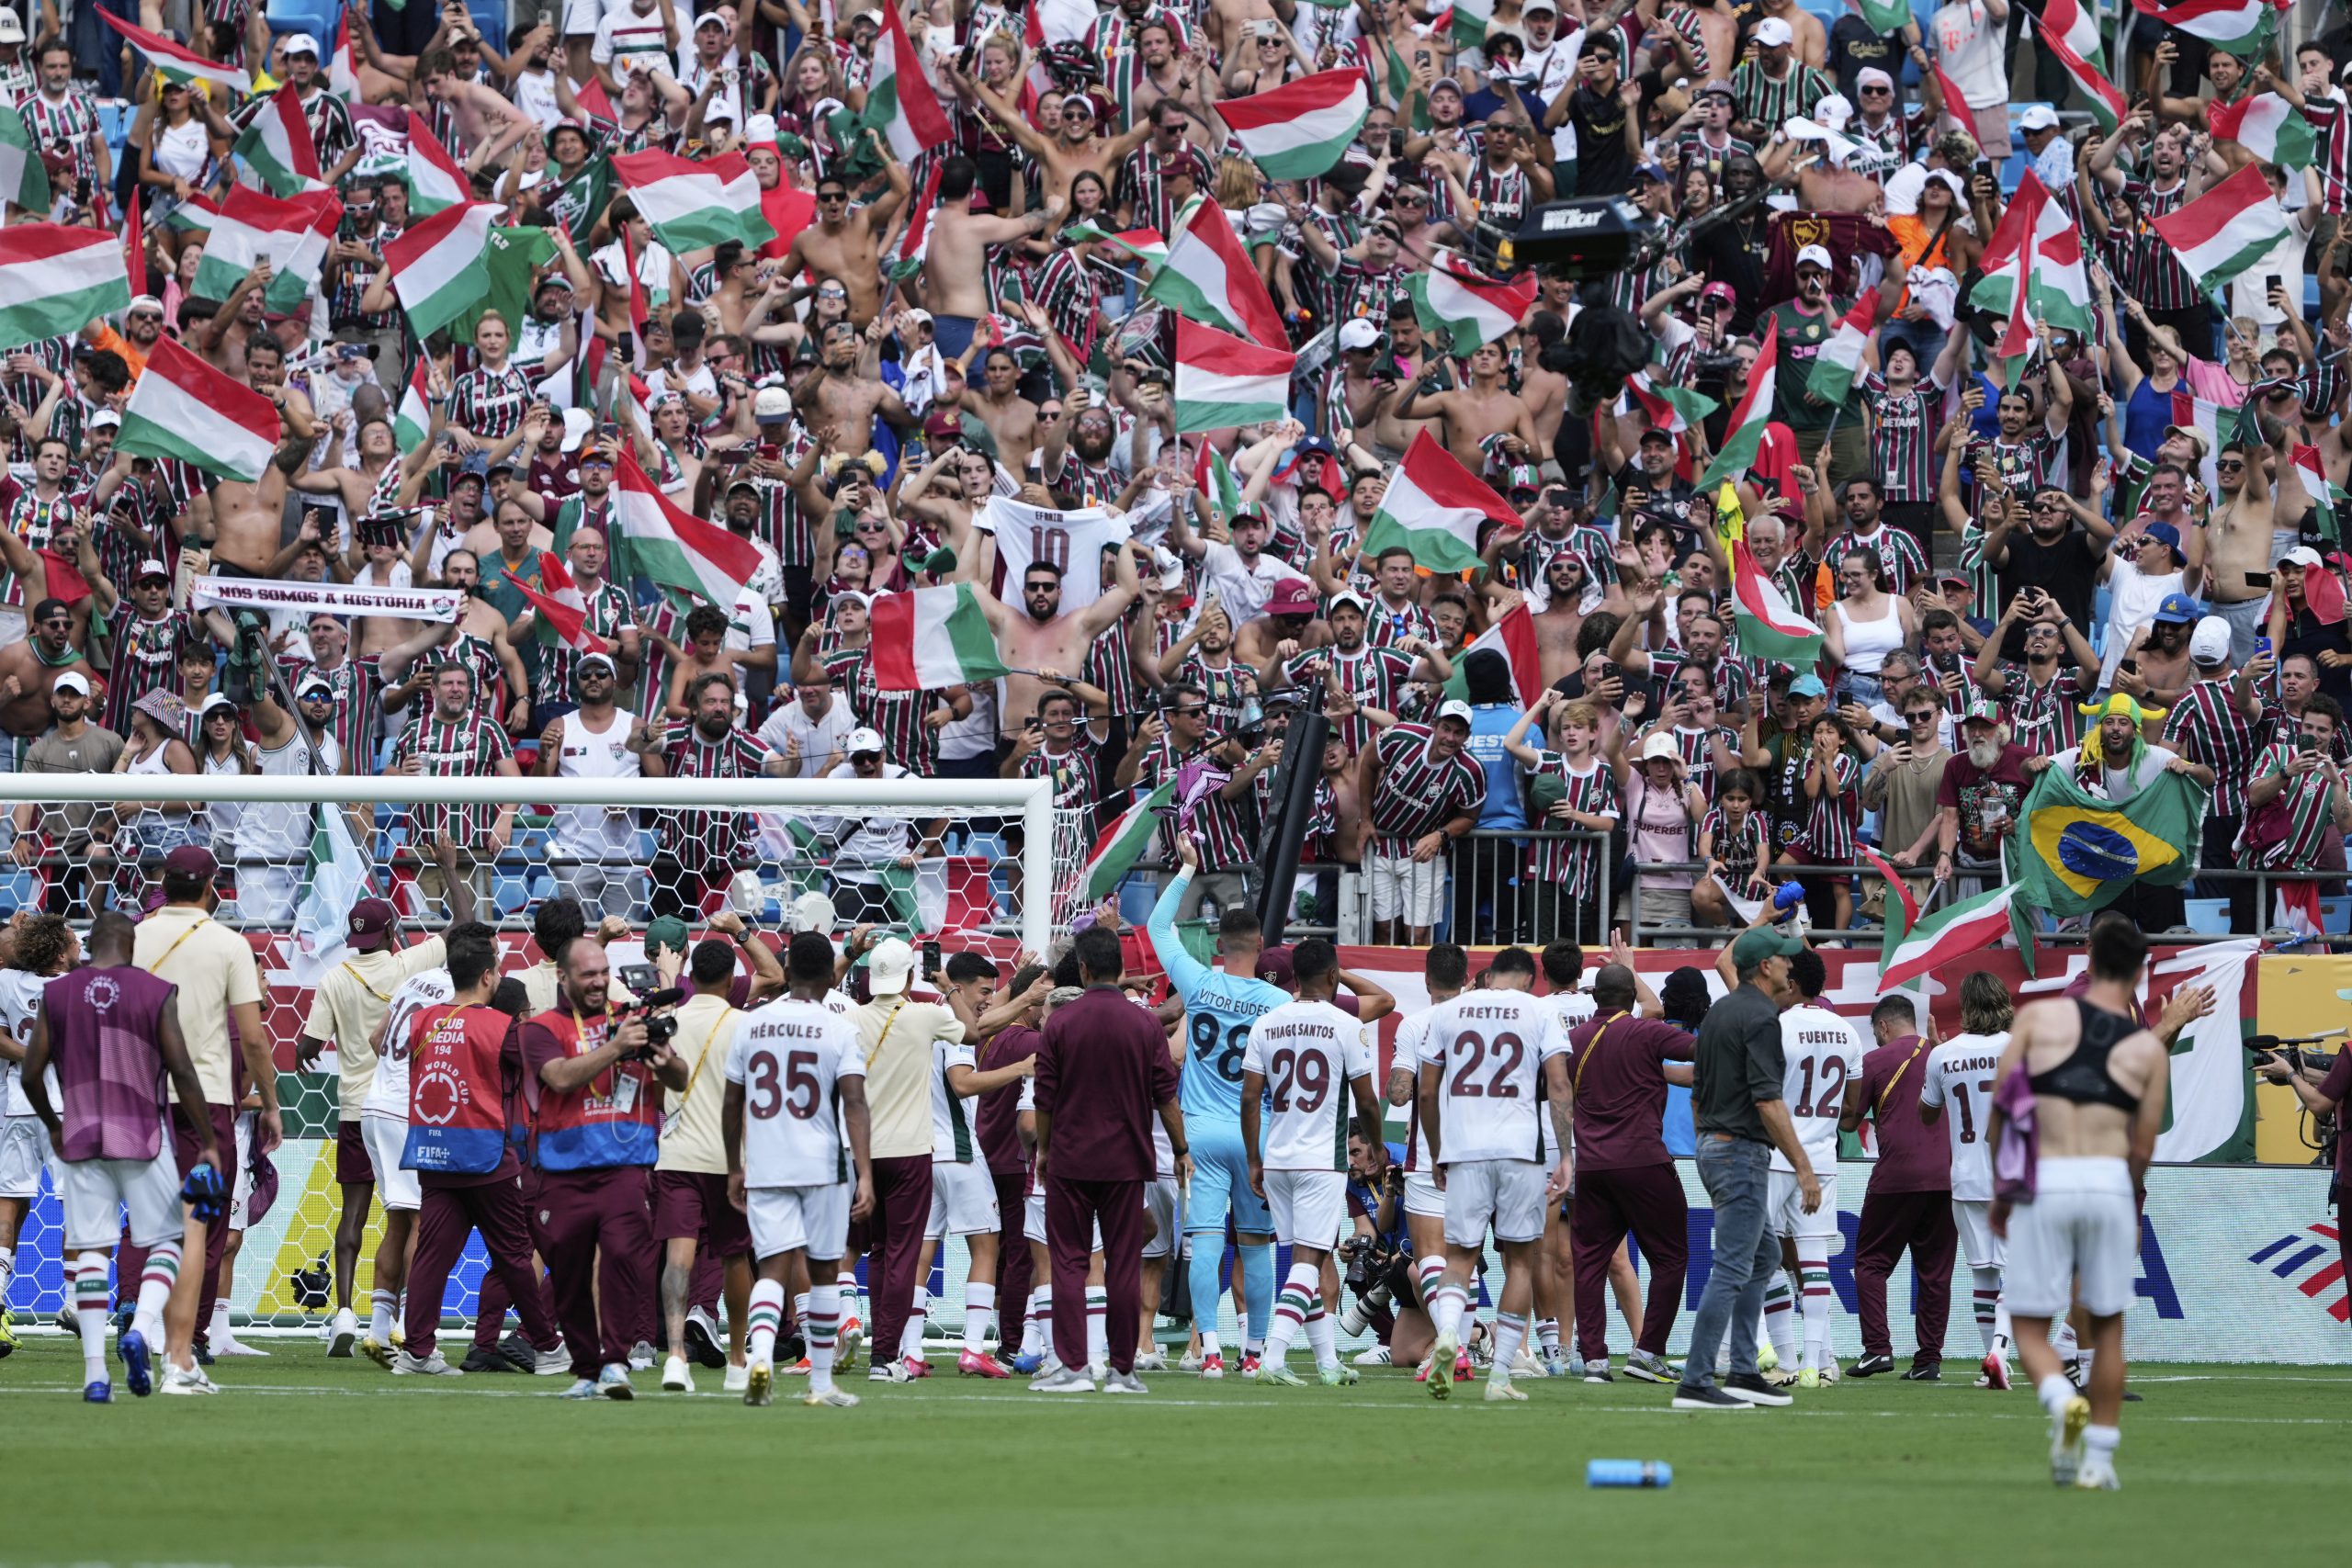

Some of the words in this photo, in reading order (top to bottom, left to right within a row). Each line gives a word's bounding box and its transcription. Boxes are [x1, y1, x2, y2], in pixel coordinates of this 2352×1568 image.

[1883, 416, 1920, 428] BETANO
[1030, 525, 1070, 575] 10
[219, 585, 253, 599] NÓS
[258, 589, 319, 604] SOMOS
[325, 592, 339, 605] A
[344, 592, 426, 611] HISTÓRIA
[135, 648, 174, 662] BETANO
[2011, 712, 2056, 729] SUPERBET
[1782, 757, 1798, 795] 2025
[1054, 778, 1086, 807] BETANO
[1387, 778, 1431, 812] SUPERBET
[1634, 820, 1689, 836] SUPERBET
[1725, 855, 1758, 867] BETANO
[1199, 988, 1231, 1010] VITOR
[1233, 1002, 1271, 1018] EUDES
[1459, 1006, 1520, 1021] FREYTES
[433, 1018, 465, 1031] CLUB
[750, 1022, 823, 1040] HÉRCULES
[1264, 1025, 1295, 1041] THIAGO
[1296, 1023, 1335, 1039] SANTOS
[426, 1031, 466, 1044] MEDIA
[1192, 1011, 1252, 1082] 98
[1798, 1031, 1848, 1045] FUENTES
[434, 1044, 452, 1055] 194
[1450, 1030, 1524, 1098] 22
[425, 1061, 459, 1078] WORLD
[458, 1078, 469, 1105] CUP
[749, 1049, 821, 1121] 35
[1272, 1048, 1329, 1113] 29
[1793, 1055, 1847, 1119] 12
[428, 1129, 447, 1138] FIFA
